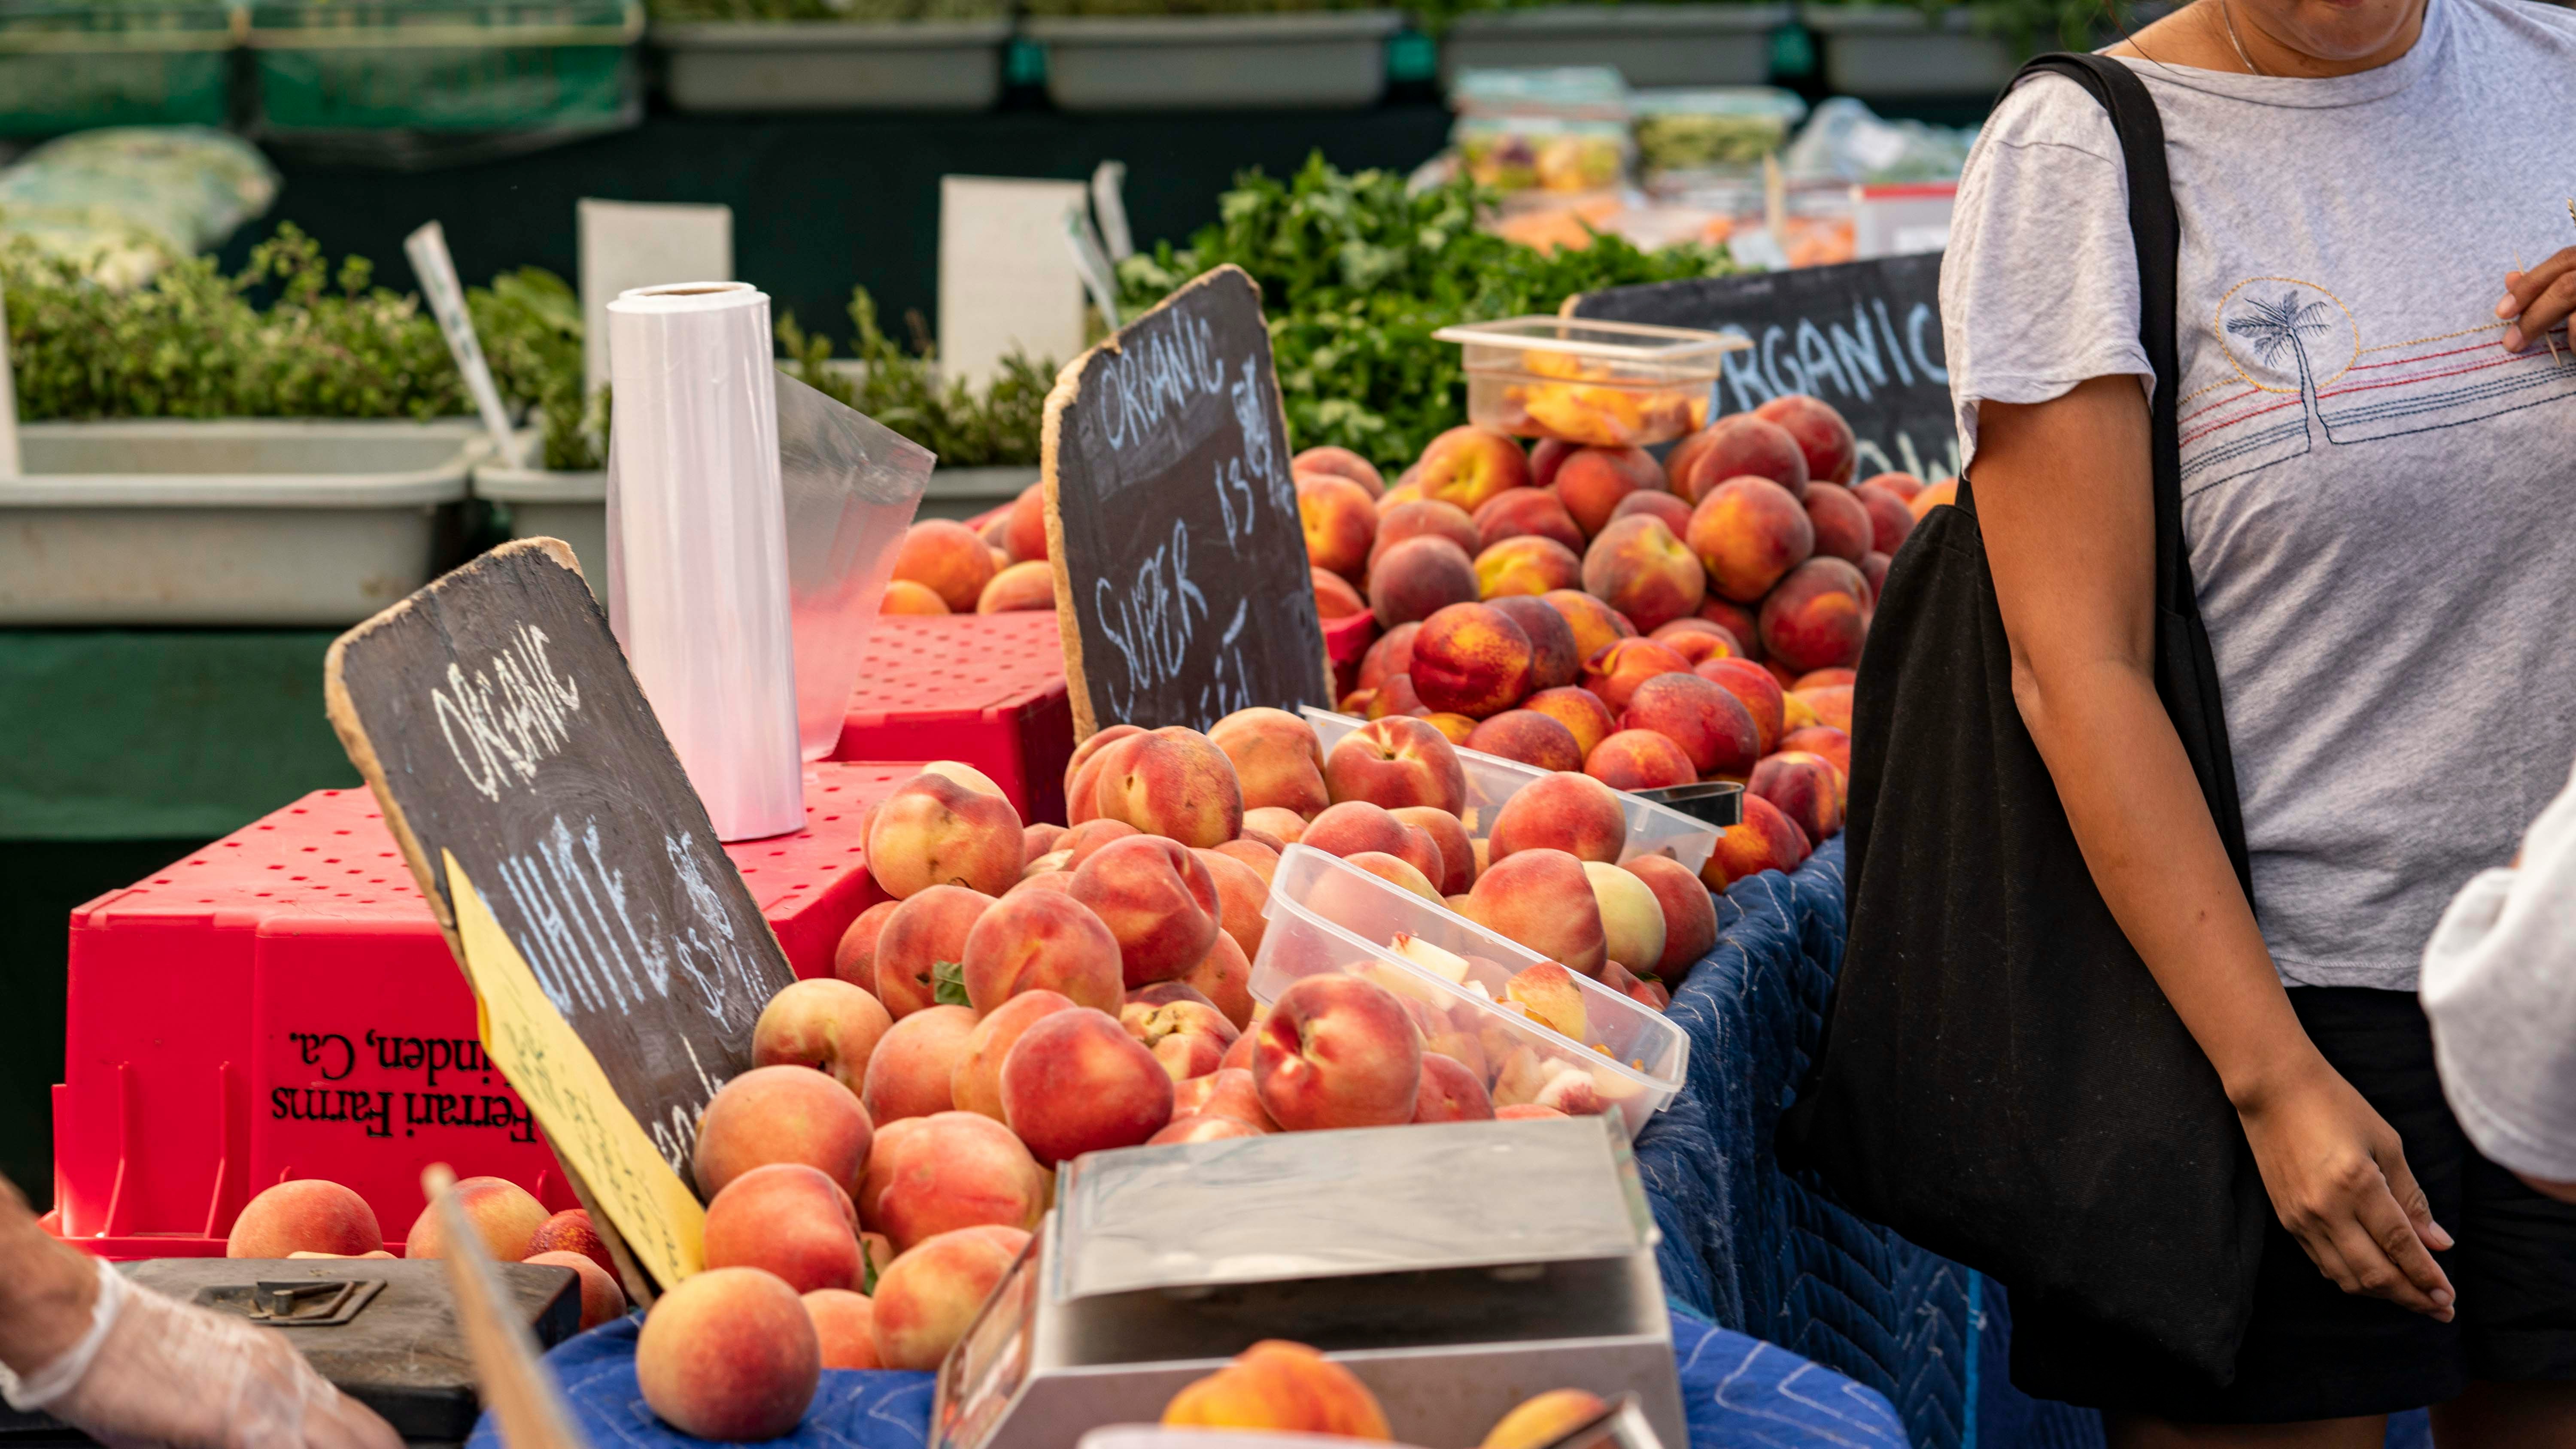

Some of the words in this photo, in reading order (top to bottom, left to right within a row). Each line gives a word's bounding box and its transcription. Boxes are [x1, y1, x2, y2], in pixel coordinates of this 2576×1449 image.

[1100, 307, 1224, 450] ORGANIC
[1096, 518, 1208, 723] SUPER
[431, 619, 580, 803] ORGANIC
[289, 1032, 355, 1080] Ca.
[366, 1029, 512, 1087] inden,
[271, 1087, 394, 1137] Farms
[404, 1092, 538, 1143] Ferrari
